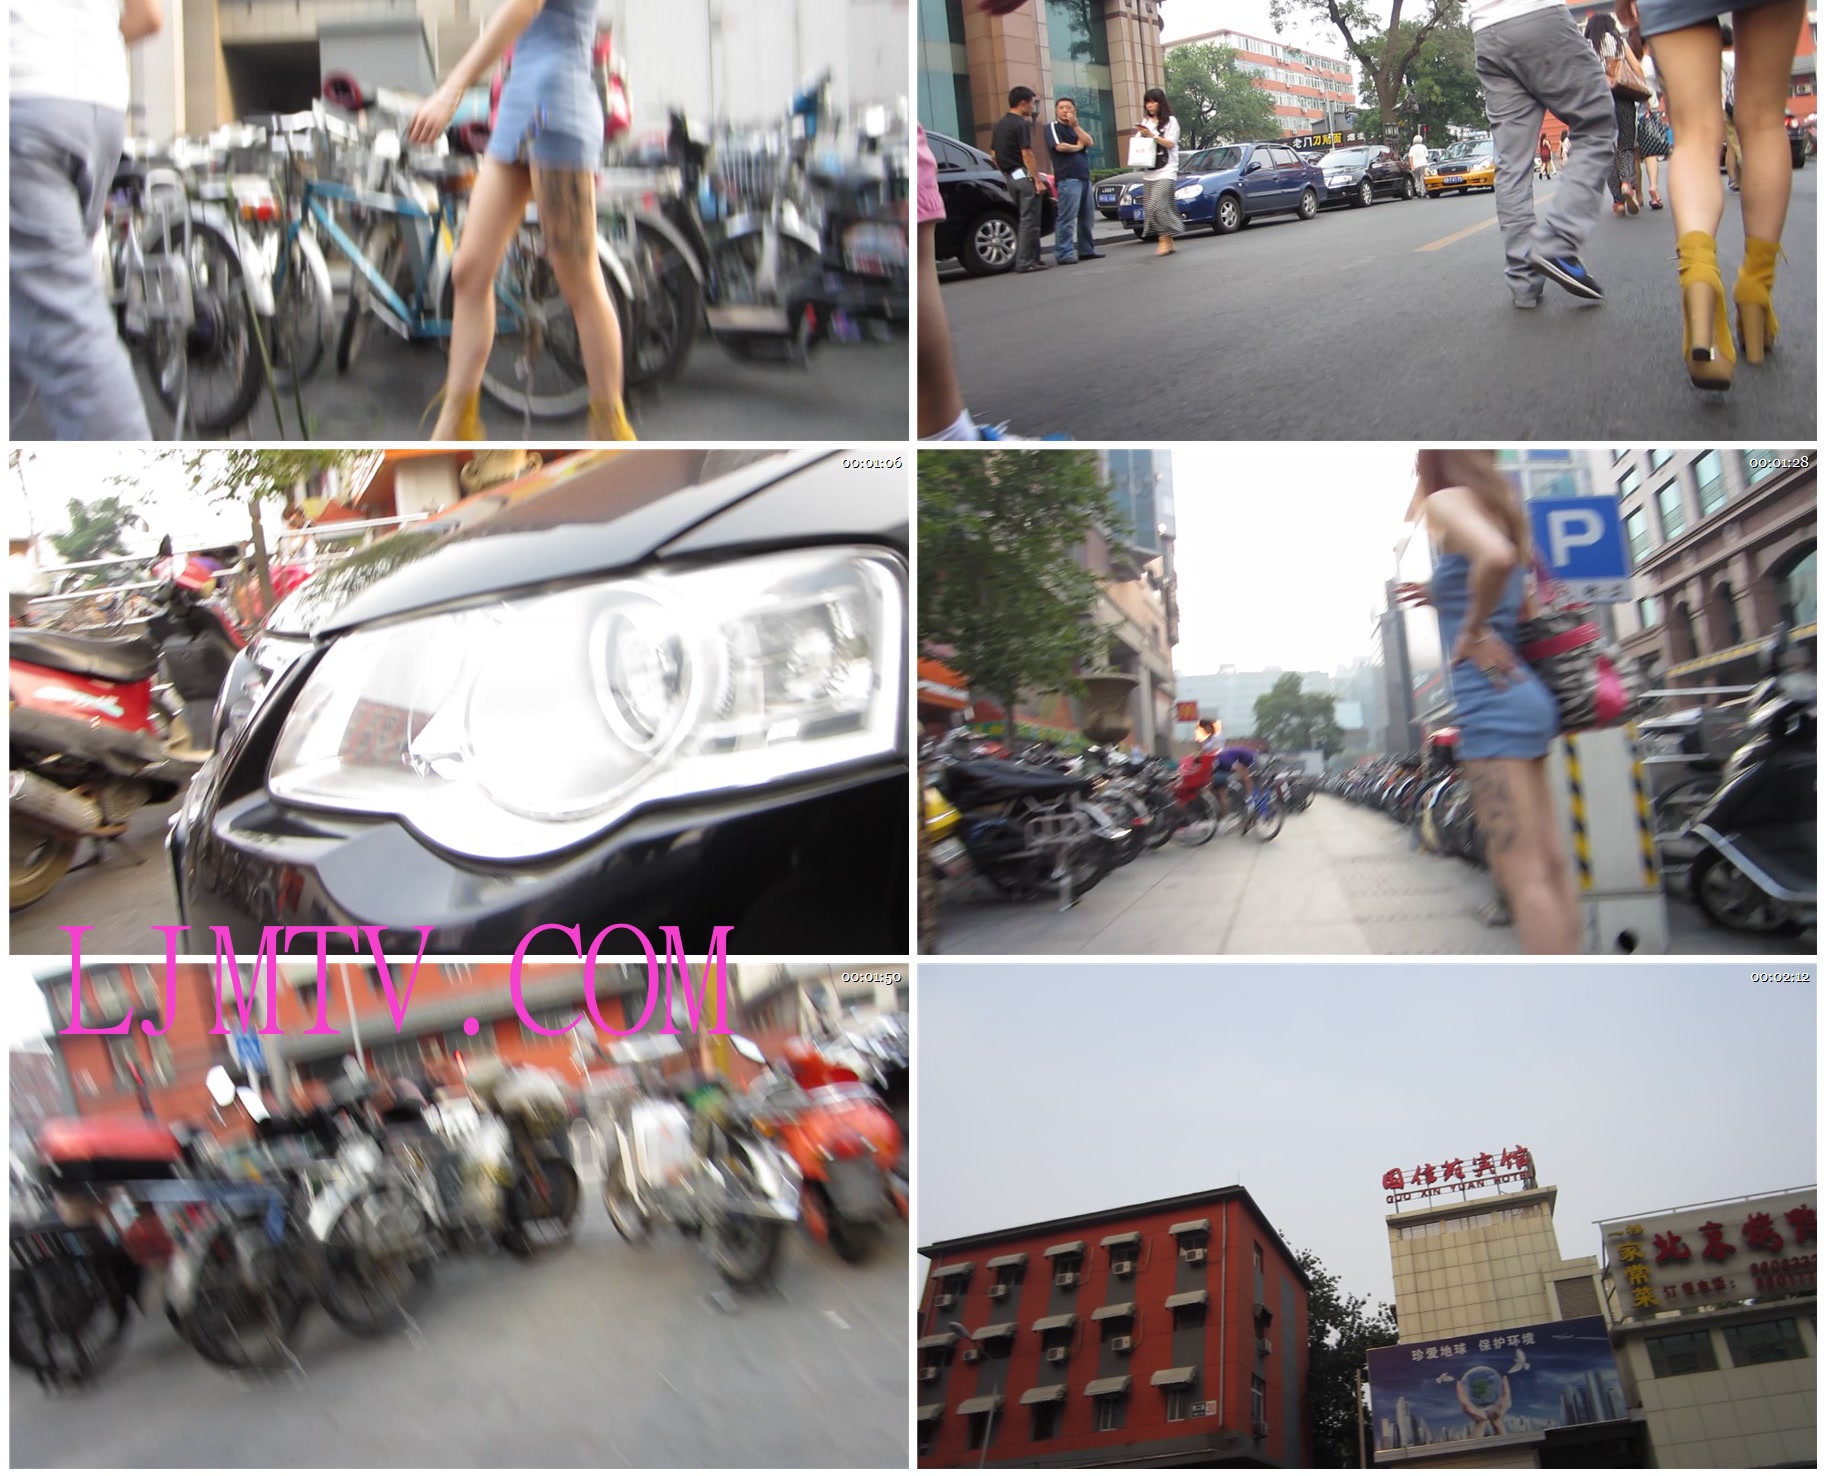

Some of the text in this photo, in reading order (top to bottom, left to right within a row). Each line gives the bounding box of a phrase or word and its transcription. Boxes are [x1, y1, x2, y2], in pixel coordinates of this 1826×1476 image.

[1546, 508, 1606, 568] P
[1382, 1144, 1531, 1190] 国信苑宾馆
[1386, 1193, 1412, 1204] GUO
[1420, 1187, 1441, 1198] XIN
[1450, 1179, 1485, 1193] YUAN
[1616, 1240, 1660, 1309] 家常菜
[1411, 1332, 1537, 1362] 珍爱地球 保护环境
